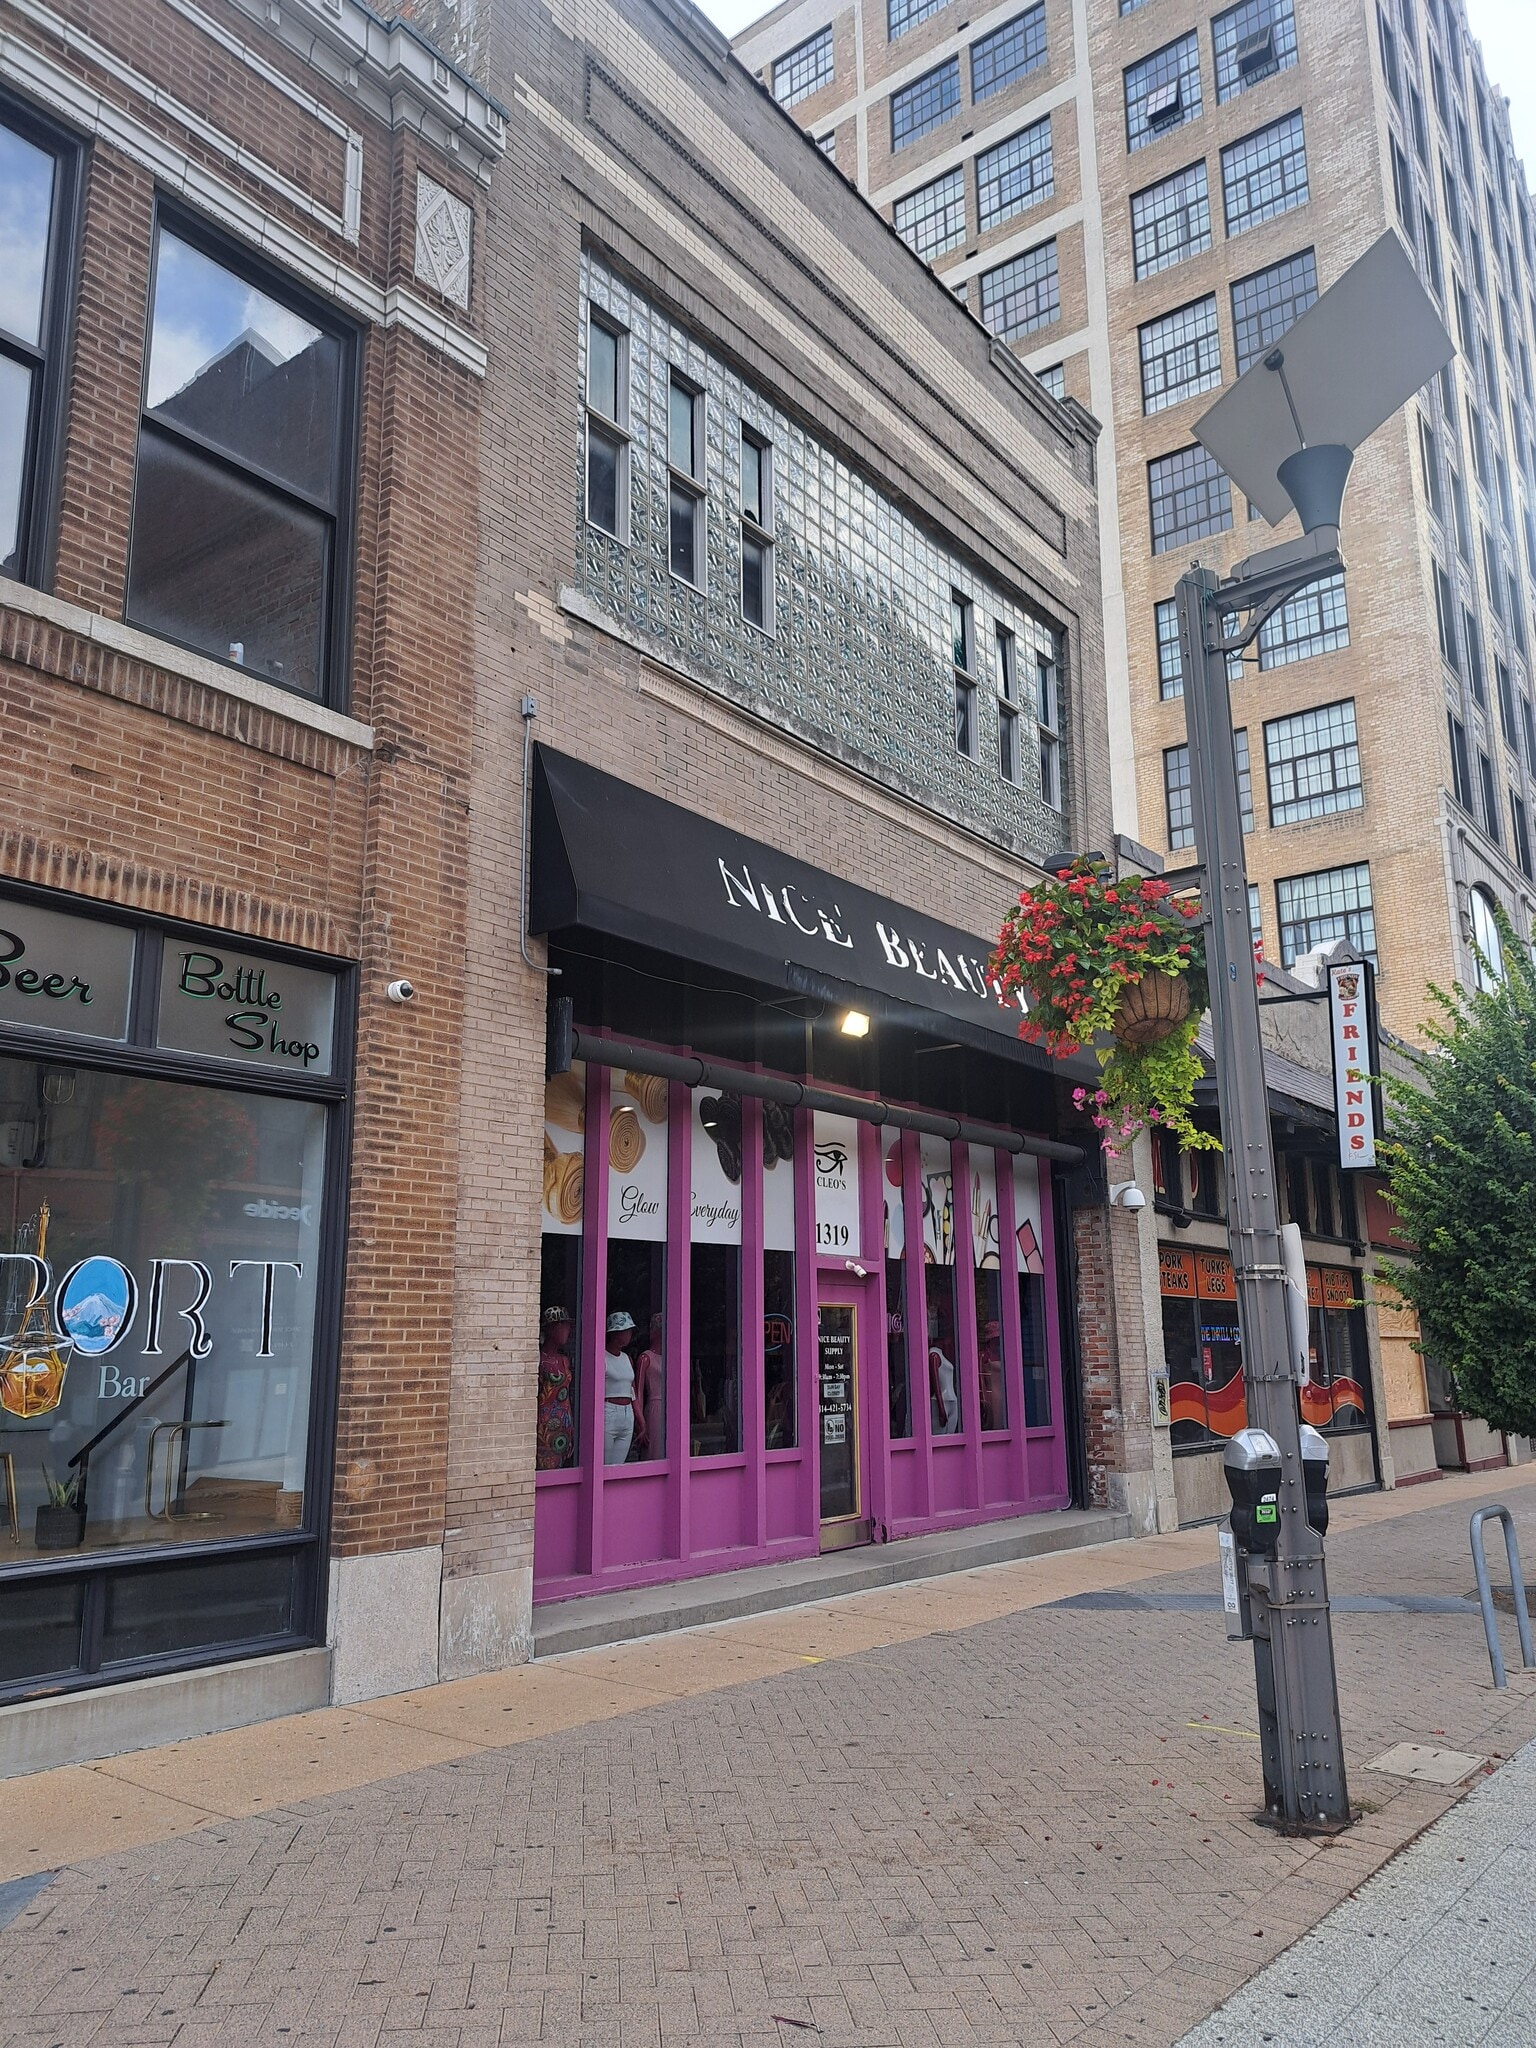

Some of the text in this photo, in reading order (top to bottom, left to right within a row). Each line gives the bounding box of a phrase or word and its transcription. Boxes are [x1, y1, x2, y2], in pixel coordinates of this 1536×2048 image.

[717, 857, 854, 949] NICE
[178, 951, 283, 1011] Bottle
[225, 1011, 321, 1068] Shop
[1342, 1002, 1366, 1150] FRIENDS
[816, 1176, 847, 1191] CLEO'S
[618, 1184, 660, 1223] Glow
[815, 1222, 849, 1247] 1319
[1159, 1251, 1183, 1270] PORK
[1200, 1258, 1231, 1276] TURKEY
[1160, 1271, 1189, 1290] TEAKS
[1205, 1277, 1226, 1294] LEGS
[818, 1335, 850, 1343] NICE BEAUTY
[825, 1347, 844, 1355] SUPPLY
[97, 1364, 151, 1400] Bar
[835, 1423, 844, 1433] NO
